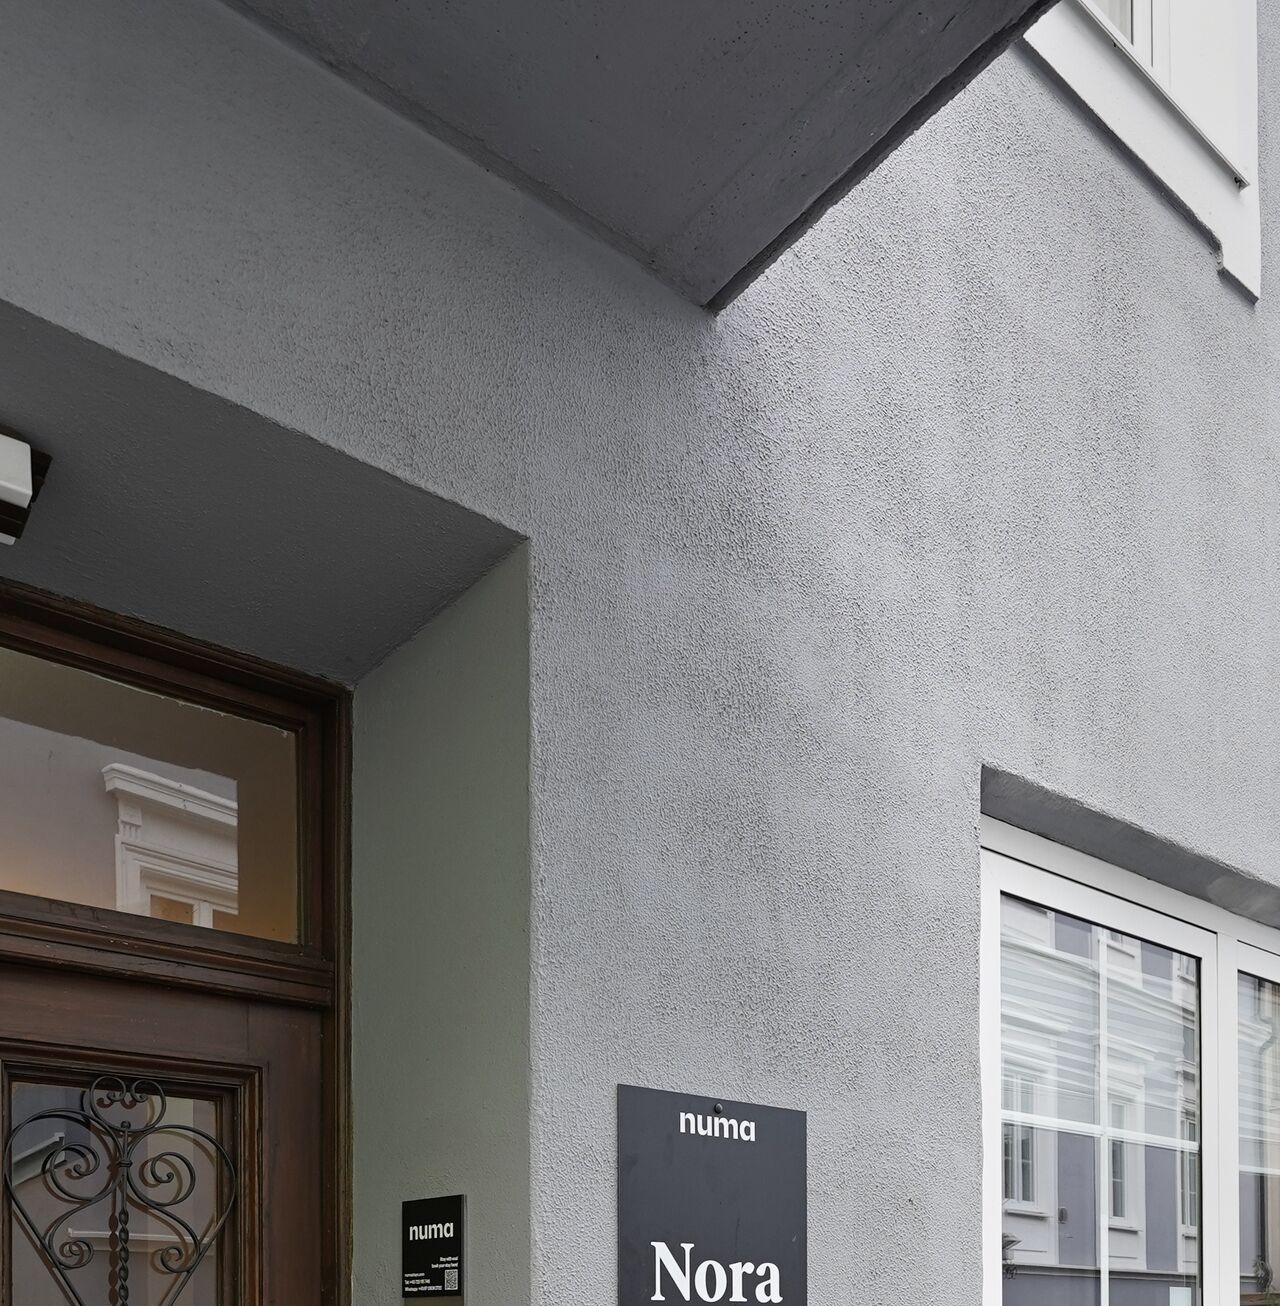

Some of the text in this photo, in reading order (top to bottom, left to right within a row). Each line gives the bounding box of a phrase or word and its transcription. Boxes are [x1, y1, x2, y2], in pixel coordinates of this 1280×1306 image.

[679, 1111, 756, 1142] numa
[409, 1222, 454, 1241] numa
[650, 1241, 784, 1304] Nora
